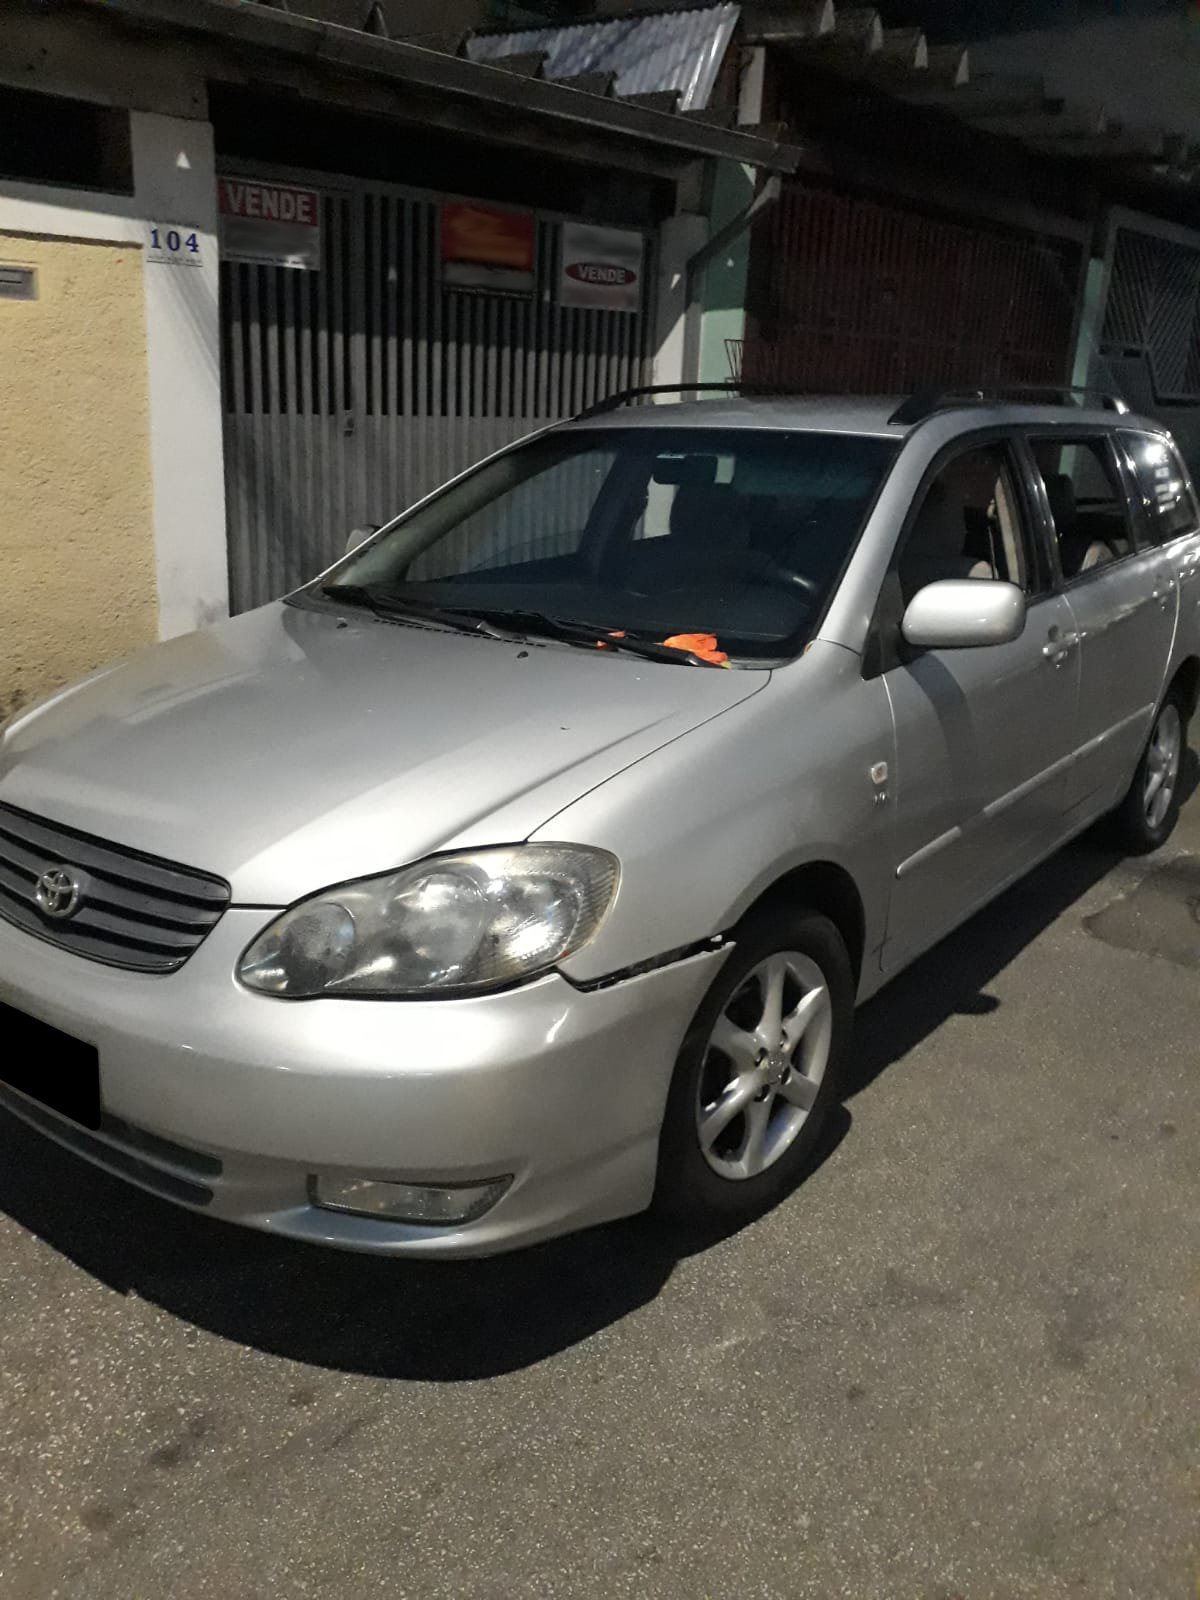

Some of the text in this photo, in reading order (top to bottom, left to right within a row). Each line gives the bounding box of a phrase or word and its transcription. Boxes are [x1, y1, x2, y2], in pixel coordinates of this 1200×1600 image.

[227, 183, 311, 222] VENDE
[151, 229, 199, 253] 104
[578, 265, 625, 283] VENDE
